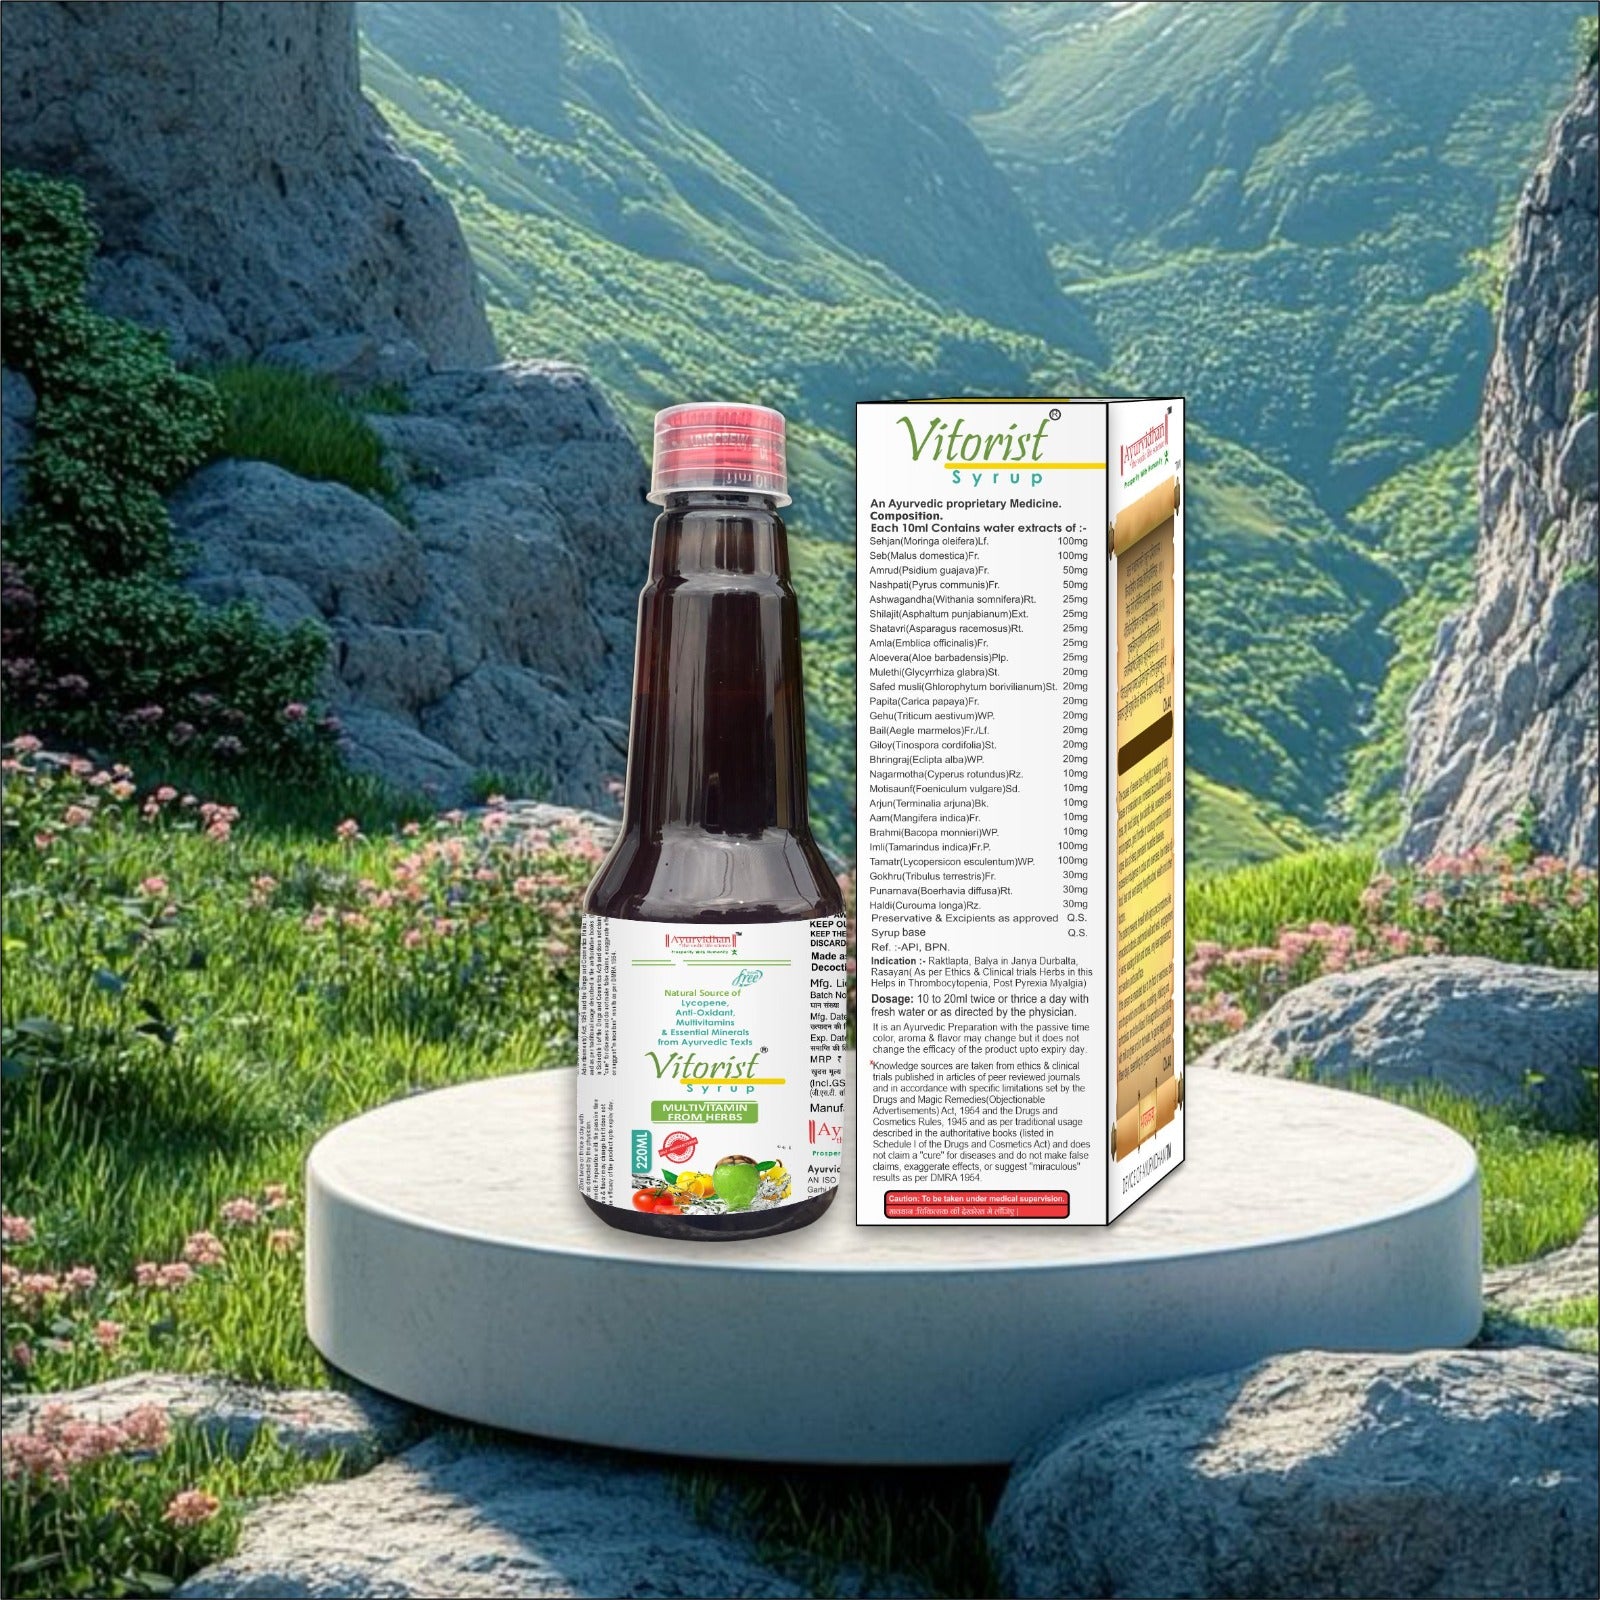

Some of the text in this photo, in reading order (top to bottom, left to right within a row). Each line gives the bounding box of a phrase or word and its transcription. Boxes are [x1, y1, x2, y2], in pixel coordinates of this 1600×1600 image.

[896, 416, 1050, 461] Vitorist
[952, 470, 1043, 487] Syrup
[870, 499, 1062, 510] An Ayurvedic proprietary Medicine.
[870, 512, 943, 522] Composition.
[871, 523, 898, 532] Each
[903, 523, 928, 532] 10ml
[932, 523, 980, 532] Contains
[984, 523, 1015, 532] water
[1018, 523, 1062, 532] extracts
[1065, 523, 1076, 532] of
[870, 537, 988, 547] Sehjan(Moringa oleifera)Lf.
[1058, 537, 1088, 547] 100mg
[870, 552, 979, 561] Seb(Malus domestica)Fr.
[1058, 551, 1088, 562] 100mg
[869, 566, 989, 576] Amrud(Psidium guajava)Fr.
[1063, 566, 1088, 576] 50mg
[870, 580, 999, 590] Nashpati(Pyrus communis)Fr.
[1063, 580, 1088, 590] 50mg
[869, 595, 1036, 605] Ashwagandha(Withania somnifera)Rt.
[1063, 595, 1088, 605] 25mg
[870, 610, 1028, 620] Shilajit(Asphaltum punjabianum)Ext.
[1063, 609, 1088, 619] 25mg
[870, 624, 1023, 634] Shatavri(Asparagus racemosus)Rt.
[1063, 624, 1088, 634] 25mg
[870, 639, 988, 649] Amla(Emblica officinalis)Fr.
[1063, 638, 1088, 648] 25mg
[869, 654, 1008, 663] Aloevera(Aloe barbadensis)Plp.
[1063, 653, 1088, 663] 25mg
[870, 668, 999, 678] Mulethi(Glycyrrhiza glabra)St.
[1063, 668, 1088, 677] 20mg
[870, 682, 1057, 692] Safed musli(Ghlorophytum borivilianum)St.
[1063, 682, 1088, 692] 20mg
[870, 697, 979, 707] Papita(Carica papaya)Fr.
[1063, 697, 1088, 706] 20mg
[870, 712, 994, 721] Gehu(Triticum aestivum)WP.
[1063, 711, 1088, 721] 20mg
[870, 726, 989, 736] Bail(Aegle marmelos)Fr./Lf.
[1063, 726, 1088, 736] 20mg
[870, 741, 996, 751] Giloy(Tinospora cordifolia)St.
[1063, 740, 1088, 750] 20mg
[811, 952, 837, 960] Made
[810, 979, 832, 989] Mfg.
[682, 1000, 729, 1008] Lycopene,
[872, 994, 913, 1005] Dosage:
[918, 994, 929, 1003] 10
[932, 994, 941, 1003] to
[944, 994, 967, 1003] 20ml
[970, 994, 995, 1003] twice
[998, 996, 1008, 1004] or
[1011, 994, 1037, 1003] thrice
[1049, 994, 1066, 1005] day
[1070, 994, 1088, 1003] with
[810, 1013, 828, 1022] Mfg.
[871, 1007, 895, 1016] fresh
[898, 1008, 925, 1016] water
[955, 1007, 993, 1016] directed
[996, 1007, 1008, 1019] by
[1011, 1007, 1026, 1016] the
[1029, 1007, 1076, 1019] physician.
[658, 1038, 678, 1046] from
[682, 1038, 728, 1047] Ayurvedic
[810, 1034, 828, 1043] Exp.
[644, 1051, 760, 1079] Vitorist
[687, 1084, 755, 1094] Syrup
[662, 1104, 748, 1112] MULTIVITAMIN
[668, 1113, 743, 1121] FROM HERBS
[636, 1132, 648, 1169] 220ML
